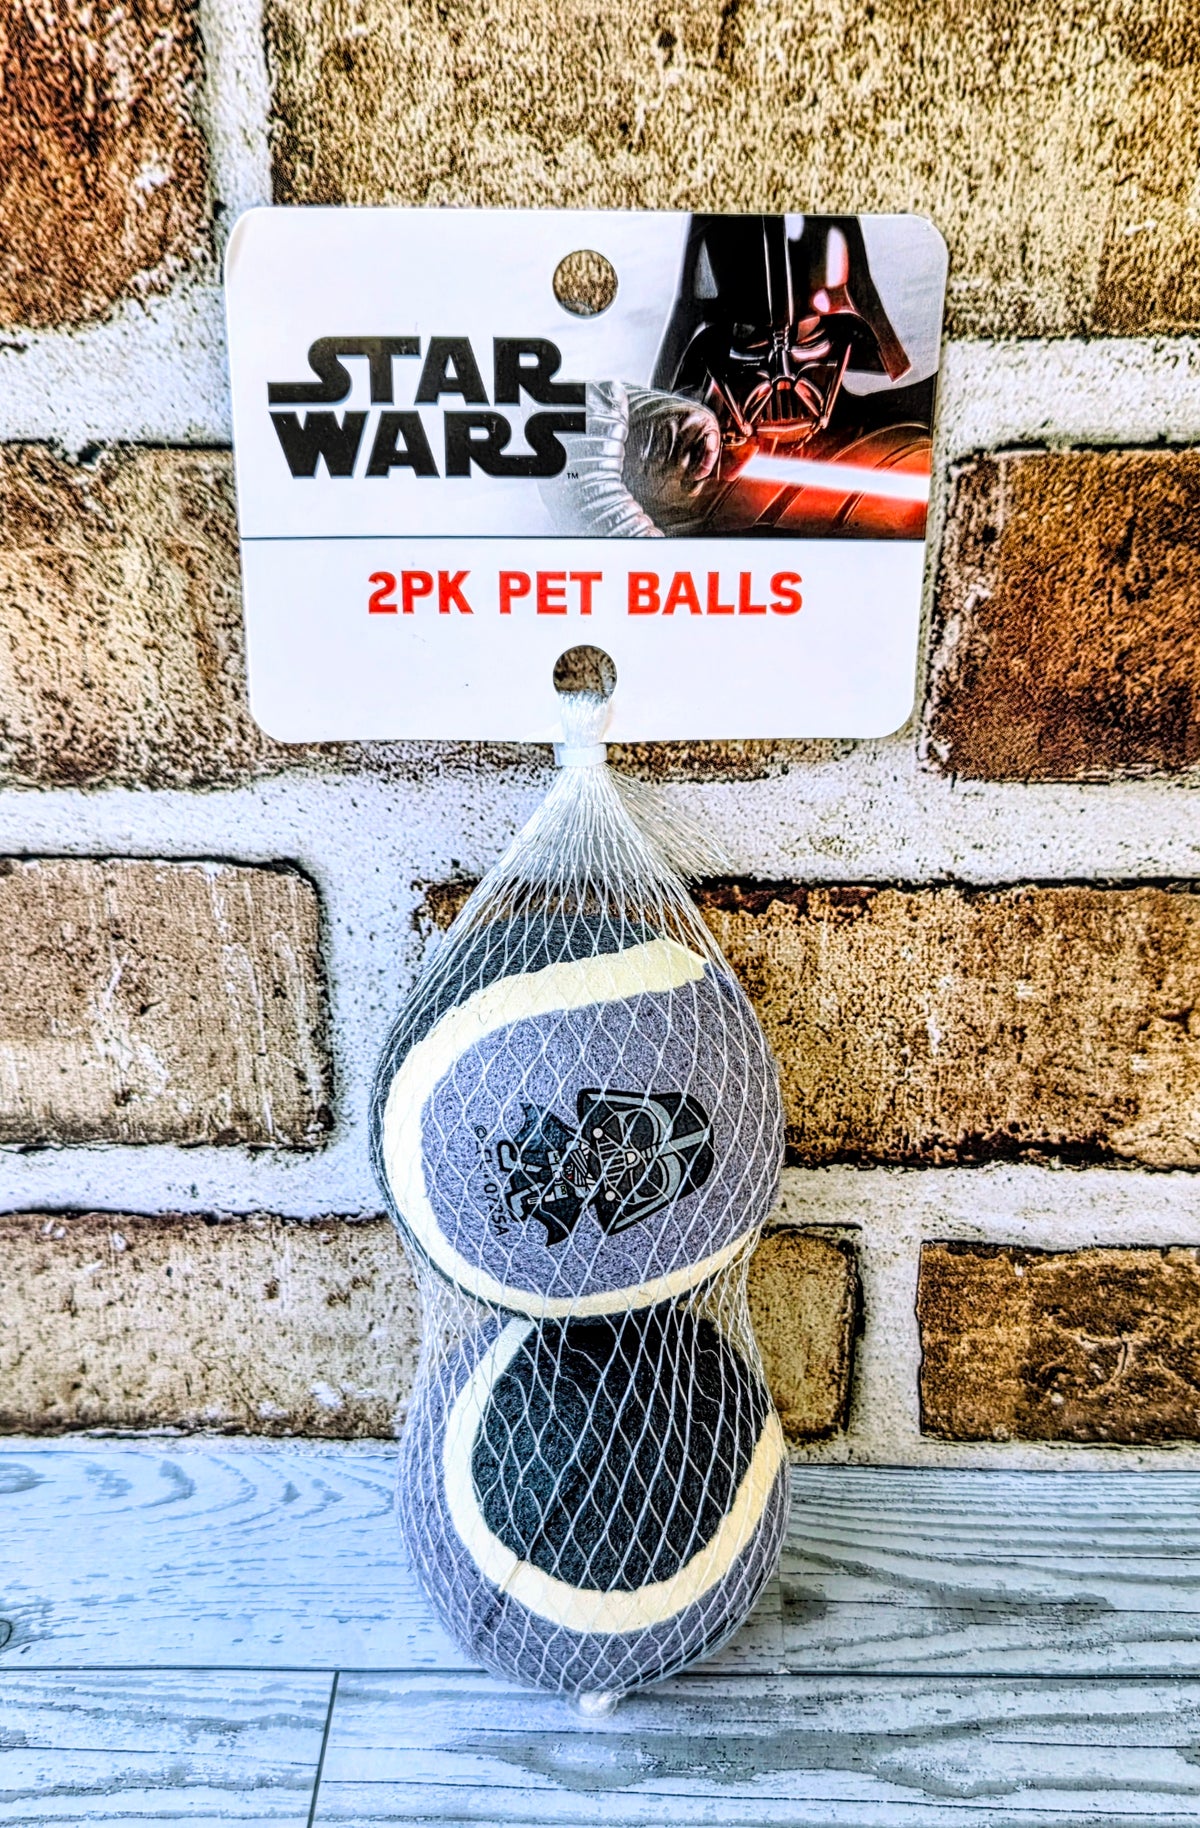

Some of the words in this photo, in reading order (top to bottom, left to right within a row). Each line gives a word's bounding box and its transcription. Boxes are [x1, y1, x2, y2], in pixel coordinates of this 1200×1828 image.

[267, 336, 586, 406] STAR
[268, 410, 586, 479] WARS
[367, 570, 474, 616] 2PK
[499, 570, 603, 616] PET
[626, 570, 803, 616] BALLS
